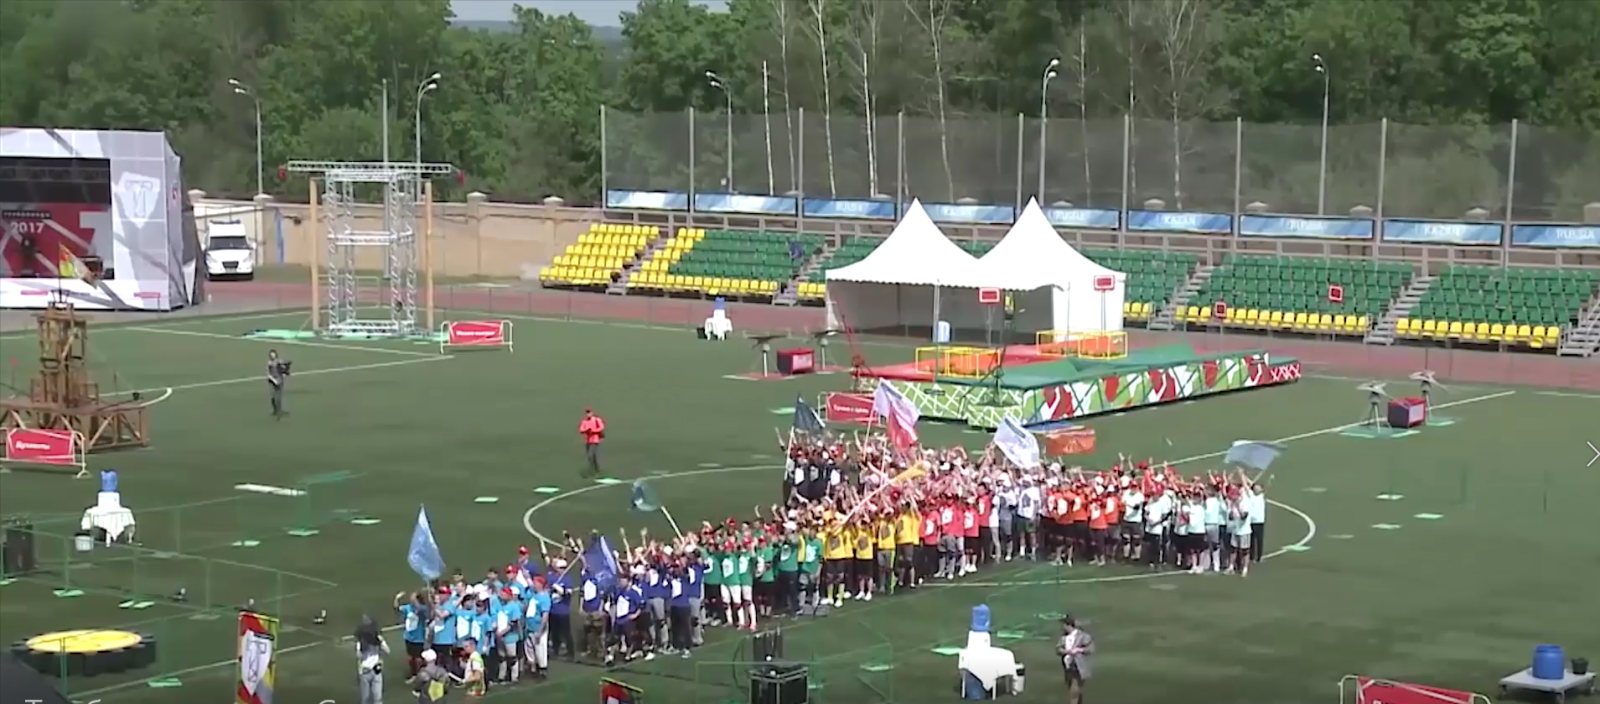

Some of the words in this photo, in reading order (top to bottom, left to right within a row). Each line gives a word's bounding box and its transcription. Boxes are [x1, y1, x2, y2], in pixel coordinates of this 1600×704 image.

[1163, 213, 1197, 226] KAZAN
[10, 222, 45, 234] 2017
[1424, 223, 1461, 237] KAZAN
[1556, 228, 1596, 240] RUSSIA
